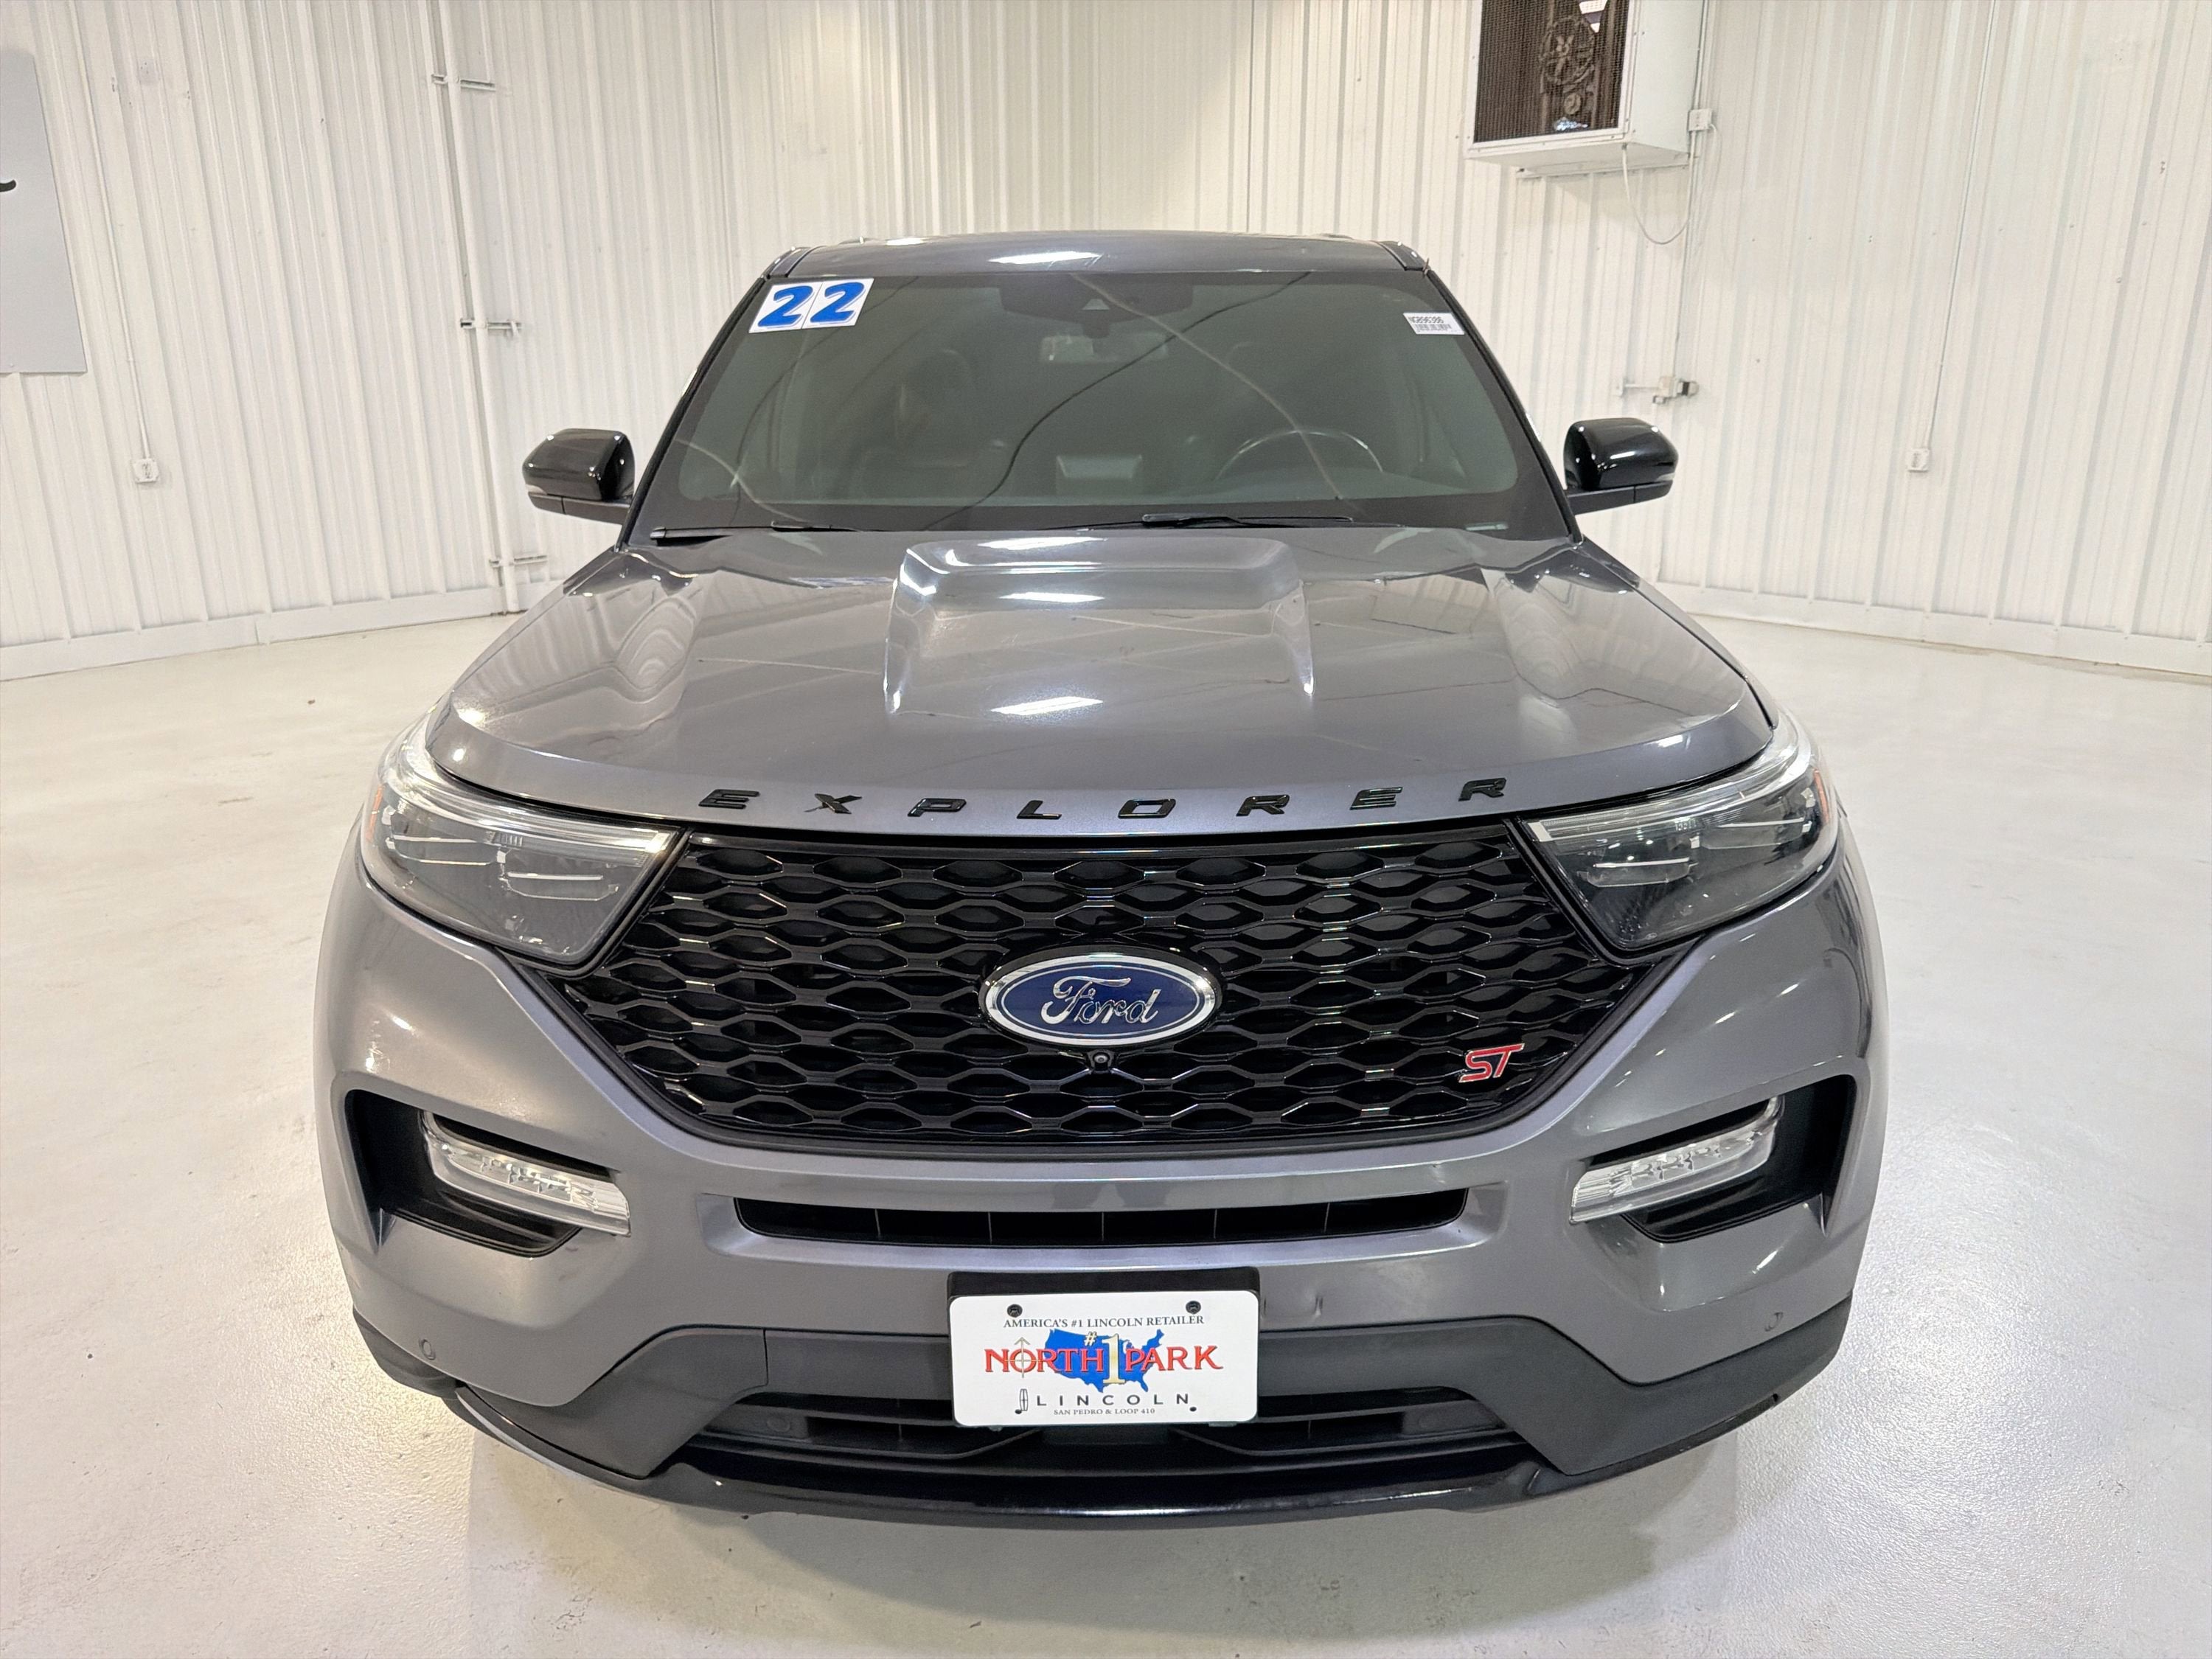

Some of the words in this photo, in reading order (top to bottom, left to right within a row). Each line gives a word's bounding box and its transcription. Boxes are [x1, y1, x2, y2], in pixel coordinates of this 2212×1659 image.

[757, 282, 865, 327] 22
[698, 777, 1506, 820] EXPLORER
[1040, 975, 1162, 1024] Ford
[1458, 1043, 1525, 1083] ST
[1004, 1318, 1068, 1328] AMERICA'S
[1071, 1319, 1082, 1328] #1
[1088, 1317, 1143, 1328] LINCOLN
[1147, 1315, 1204, 1326] RETAILER
[984, 1348, 1105, 1373] NORTH
[1125, 1346, 1224, 1372] PARK
[1037, 1393, 1189, 1406] LINCOLN
